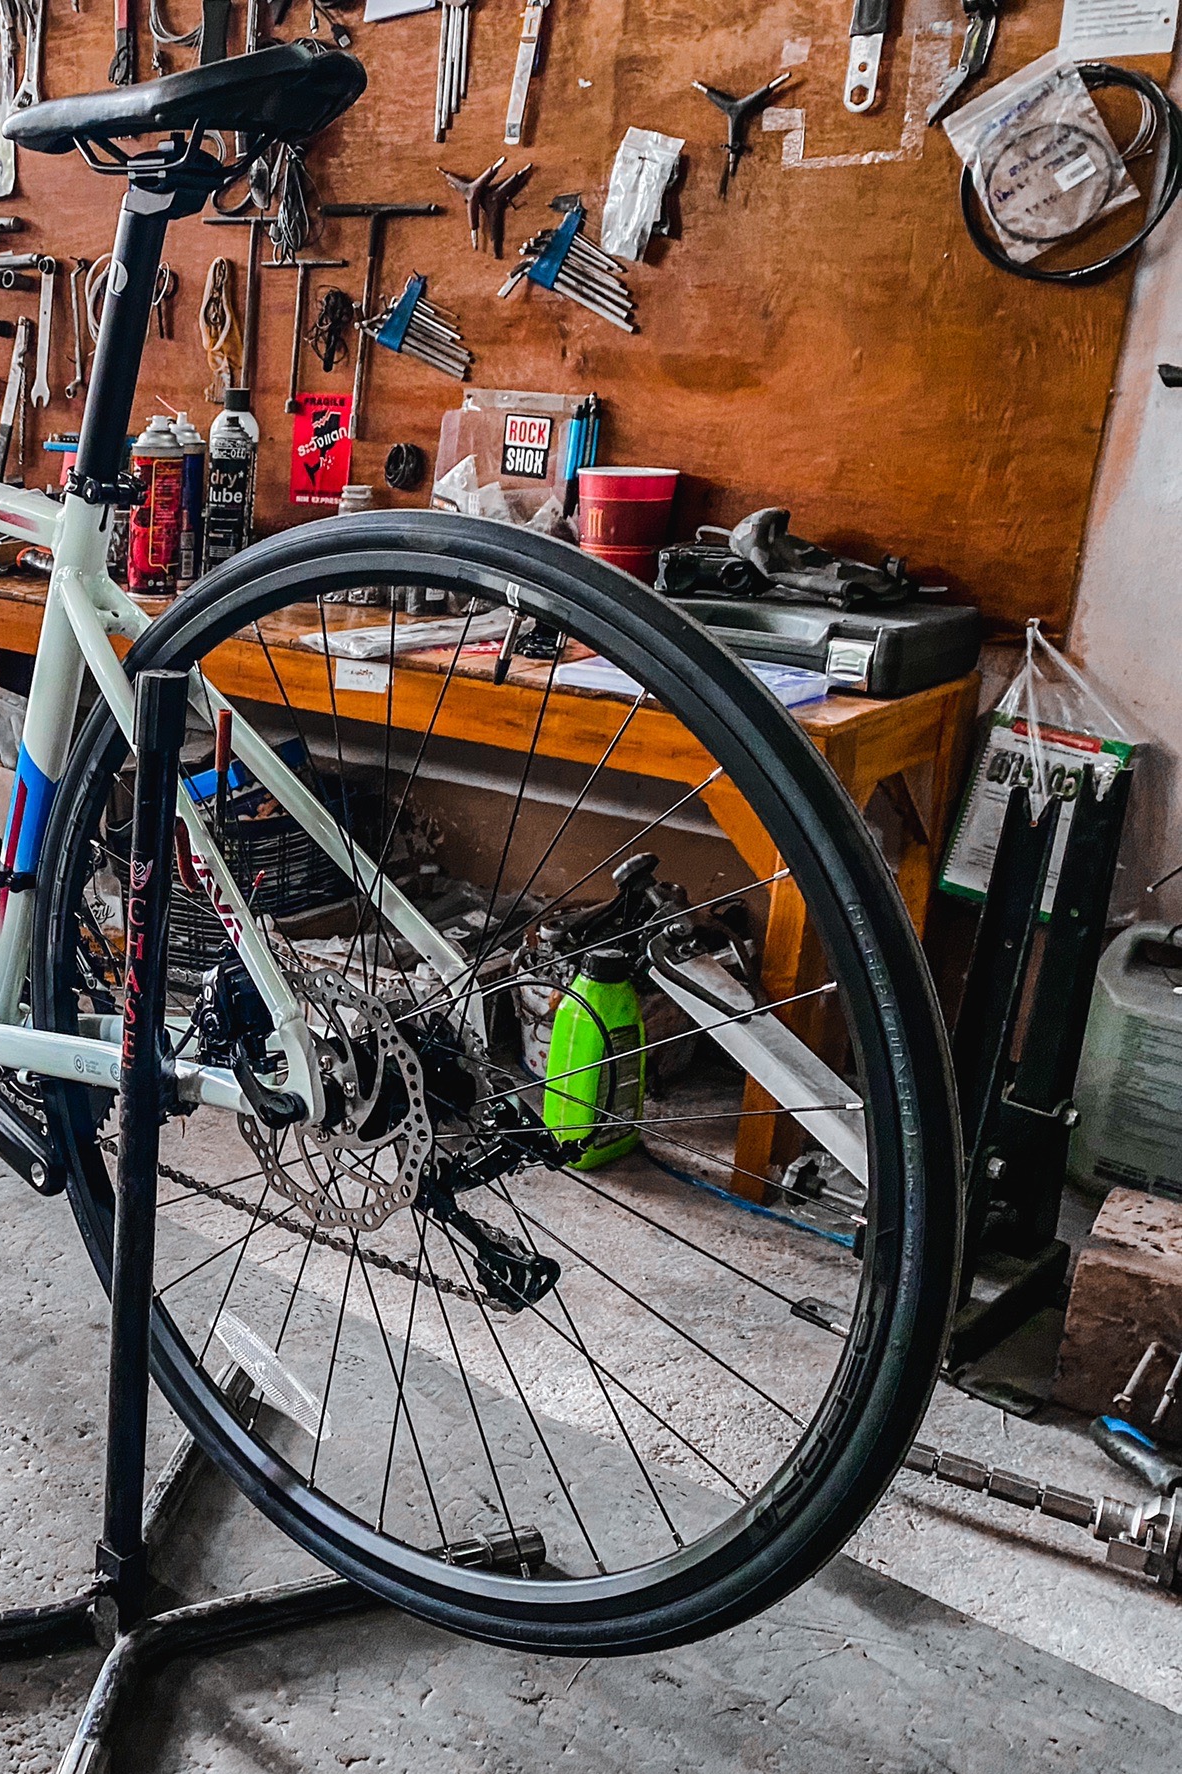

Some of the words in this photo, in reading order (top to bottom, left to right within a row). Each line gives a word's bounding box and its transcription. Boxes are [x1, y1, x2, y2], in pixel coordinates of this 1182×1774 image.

[303, 396, 346, 407] FRAGILE
[508, 419, 548, 446] ROCK
[505, 447, 545, 475] SHOX
[209, 486, 243, 504] lube
[121, 896, 148, 1060] CHASE
